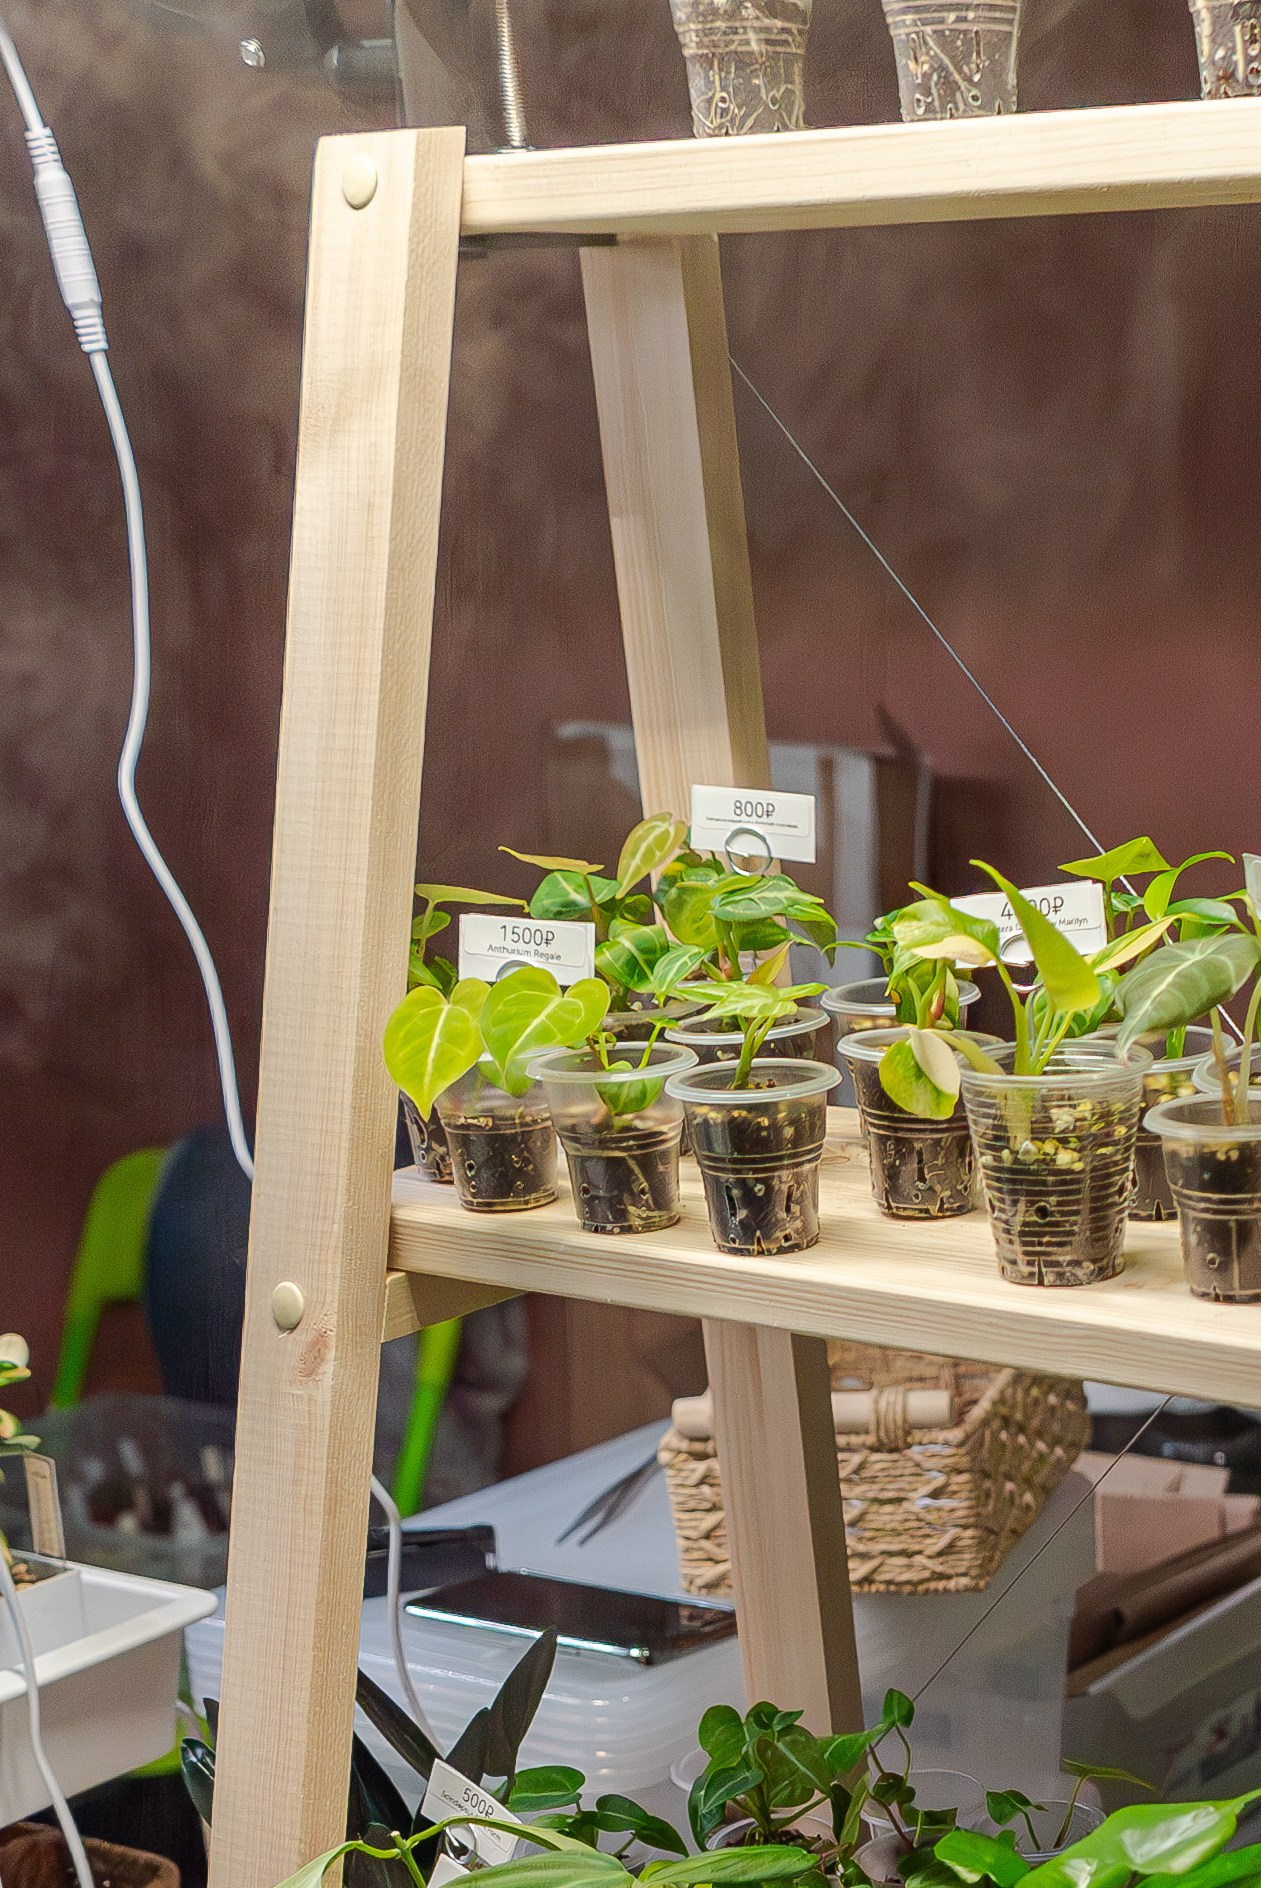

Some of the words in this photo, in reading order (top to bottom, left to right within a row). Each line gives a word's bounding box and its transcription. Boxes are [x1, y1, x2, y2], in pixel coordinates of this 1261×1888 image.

[733, 799, 776, 819] 800₽
[499, 924, 555, 947] 1500₽
[487, 943, 532, 957] Anthurium
[533, 948, 562, 961] Regale
[462, 1787, 495, 1818] 500₽
